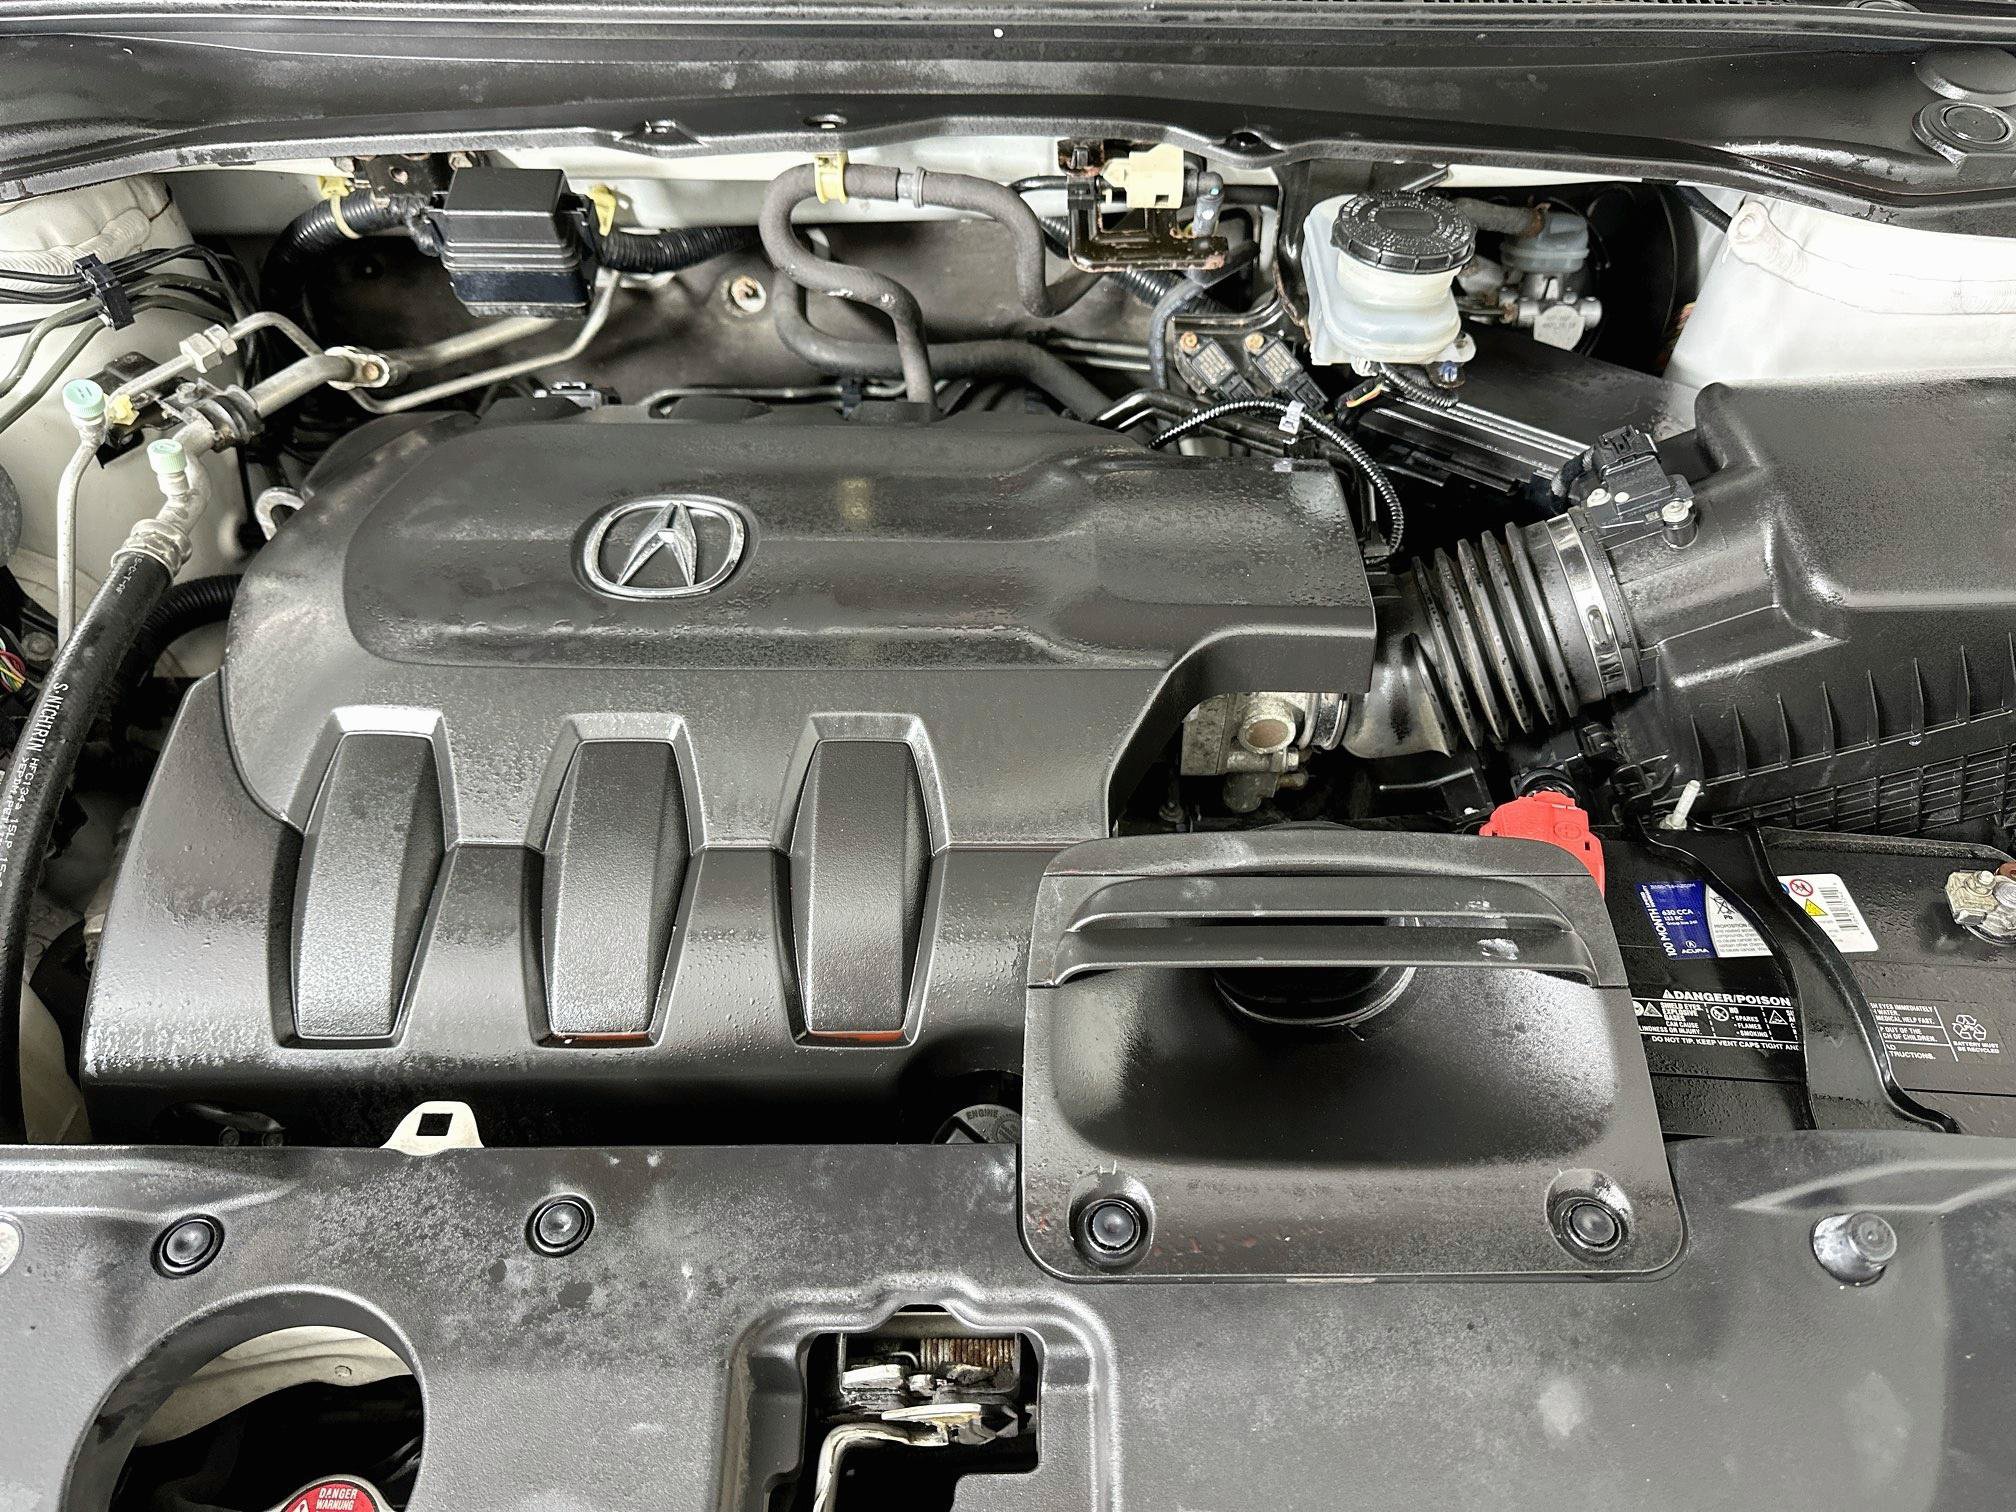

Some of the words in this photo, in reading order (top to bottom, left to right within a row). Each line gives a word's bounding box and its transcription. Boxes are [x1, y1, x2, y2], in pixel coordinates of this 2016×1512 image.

[14, 757, 40, 810] HFC134a
[5, 818, 19, 849] 15LP
[1647, 908, 1671, 942] MONTH
[1662, 941, 1677, 957] 100
[1673, 990, 1792, 1006] DANGER/POISON
[1660, 1002, 1683, 1010] SHIELD
[1894, 1004, 1933, 1013] IMMEDIATELY
[1662, 1009, 1698, 1017] EXPLOSIVE
[1679, 1021, 1699, 1029] CAUSE
[1740, 1030, 1768, 1038] SMOKING
[1902, 1034, 1938, 1042] CHILDREN.
[1760, 1042, 1784, 1050] TIGHT
[1888, 1051, 1937, 1060] TRUCTIONS.
[965, 1108, 1000, 1121] ENGINE
[319, 1488, 358, 1500] DANGER
[316, 1500, 355, 1511] WARNUNG
